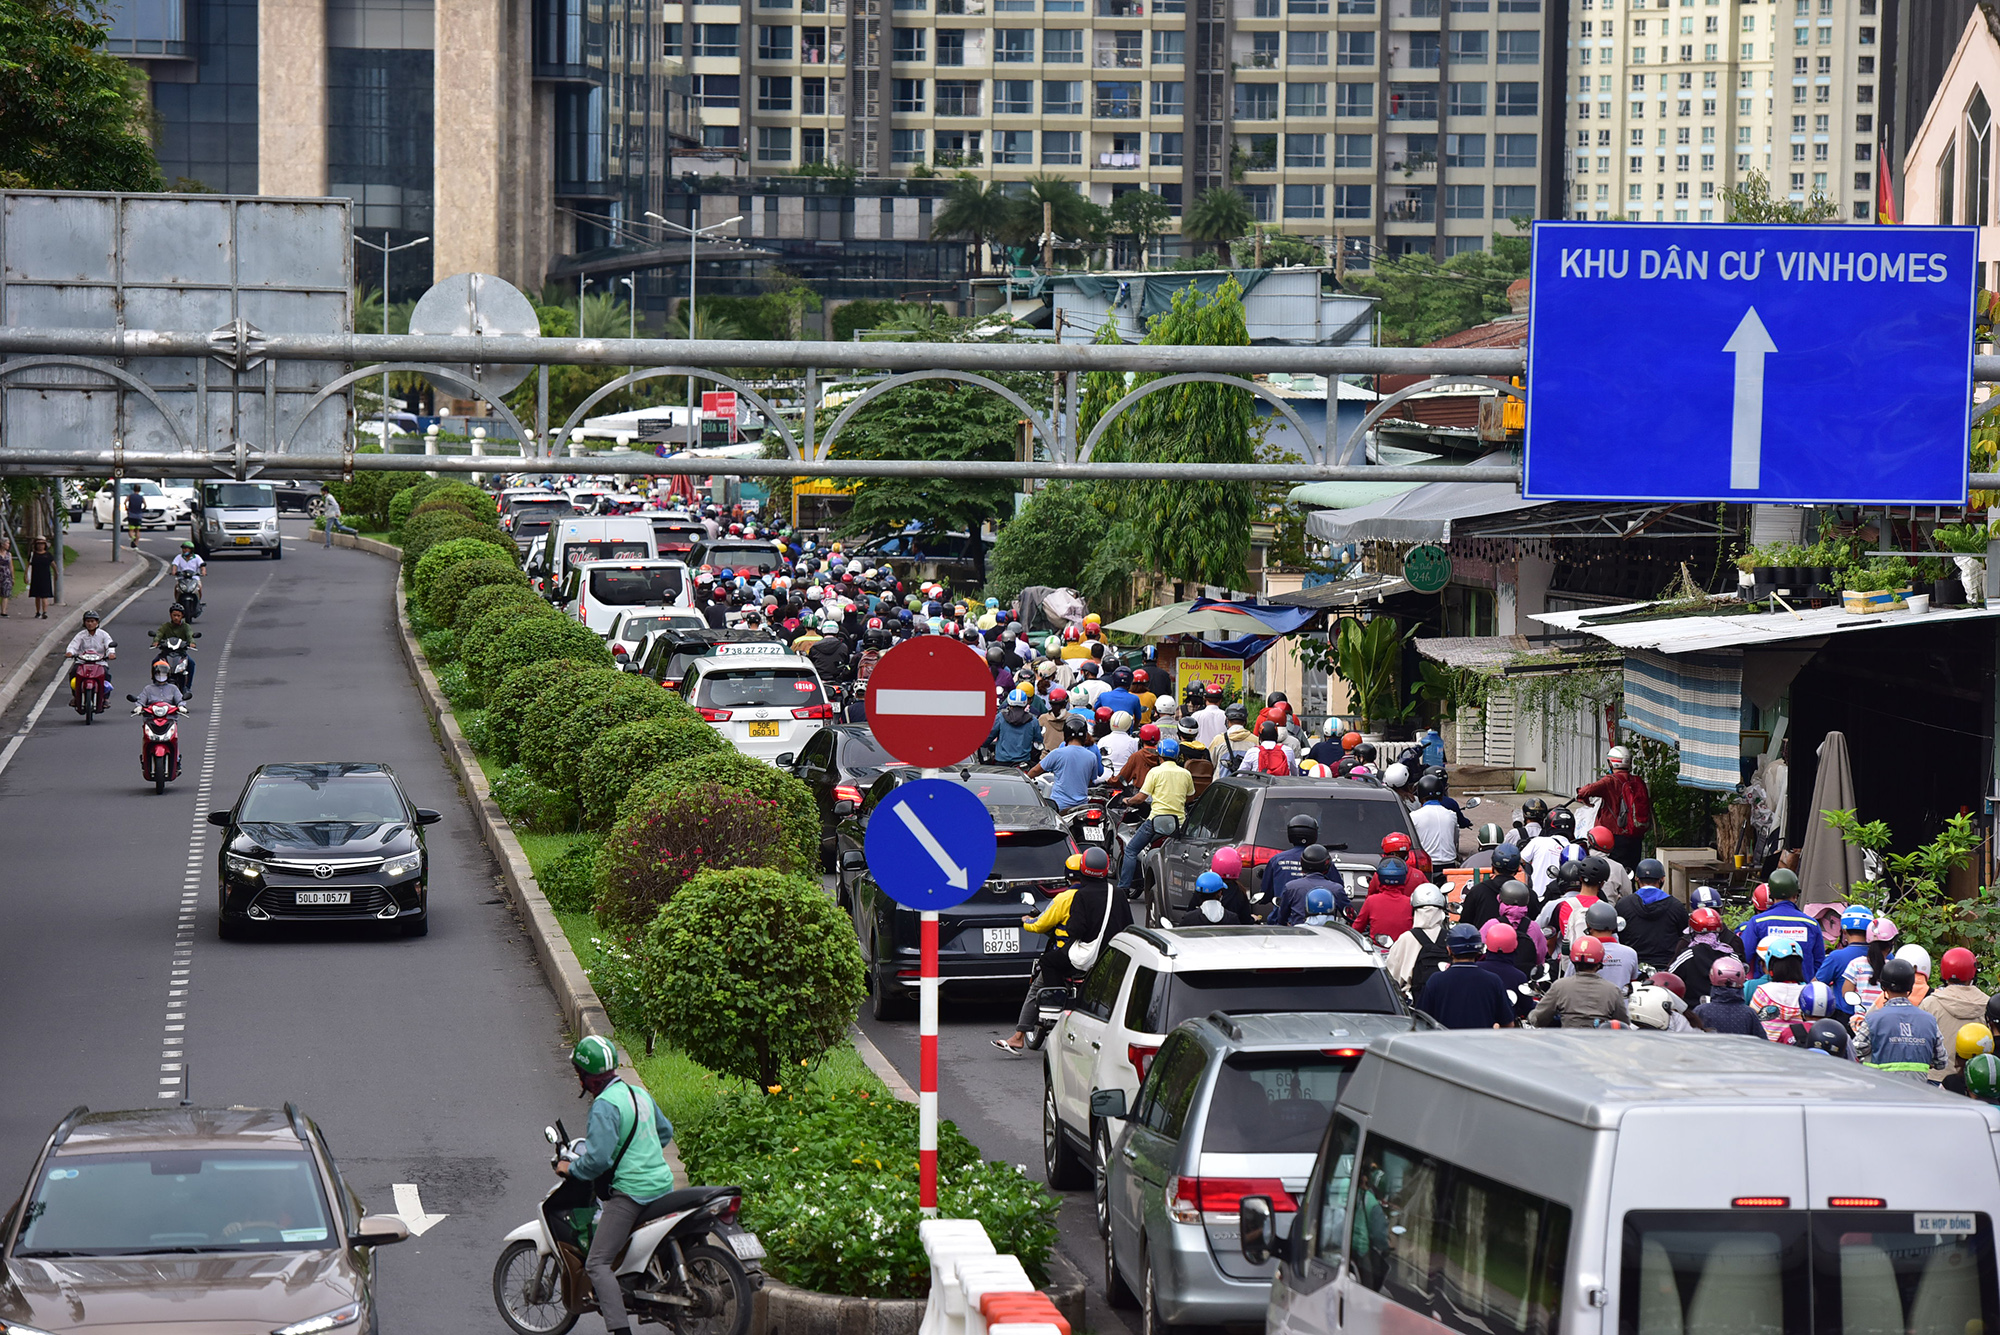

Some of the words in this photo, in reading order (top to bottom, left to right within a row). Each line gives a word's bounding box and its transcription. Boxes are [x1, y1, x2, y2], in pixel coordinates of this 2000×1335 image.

[1560, 247, 1629, 279] KHU
[1639, 244, 1709, 280] DÂN
[1719, 248, 1766, 281] CƯ
[1777, 251, 1949, 283] VINHOMES
[702, 420, 717, 433] SỬA
[718, 422, 728, 433] XE
[1412, 571, 1431, 582] 24h
[1180, 660, 1202, 671] Chuỗi
[1203, 661, 1219, 671] Nhà
[1221, 662, 1241, 673] Hàng
[1212, 673, 1232, 685] 757
[794, 682, 813, 690] 18149
[991, 929, 1011, 941] 51H
[984, 940, 1019, 952] 687.95
[1888, 1036, 1927, 1044] NEWTECONS
[575, 1051, 591, 1065] Grab
[1920, 1219, 1930, 1230] XE
[1931, 1218, 1948, 1232] HỢP
[1949, 1214, 1972, 1230] ĐỒNG
